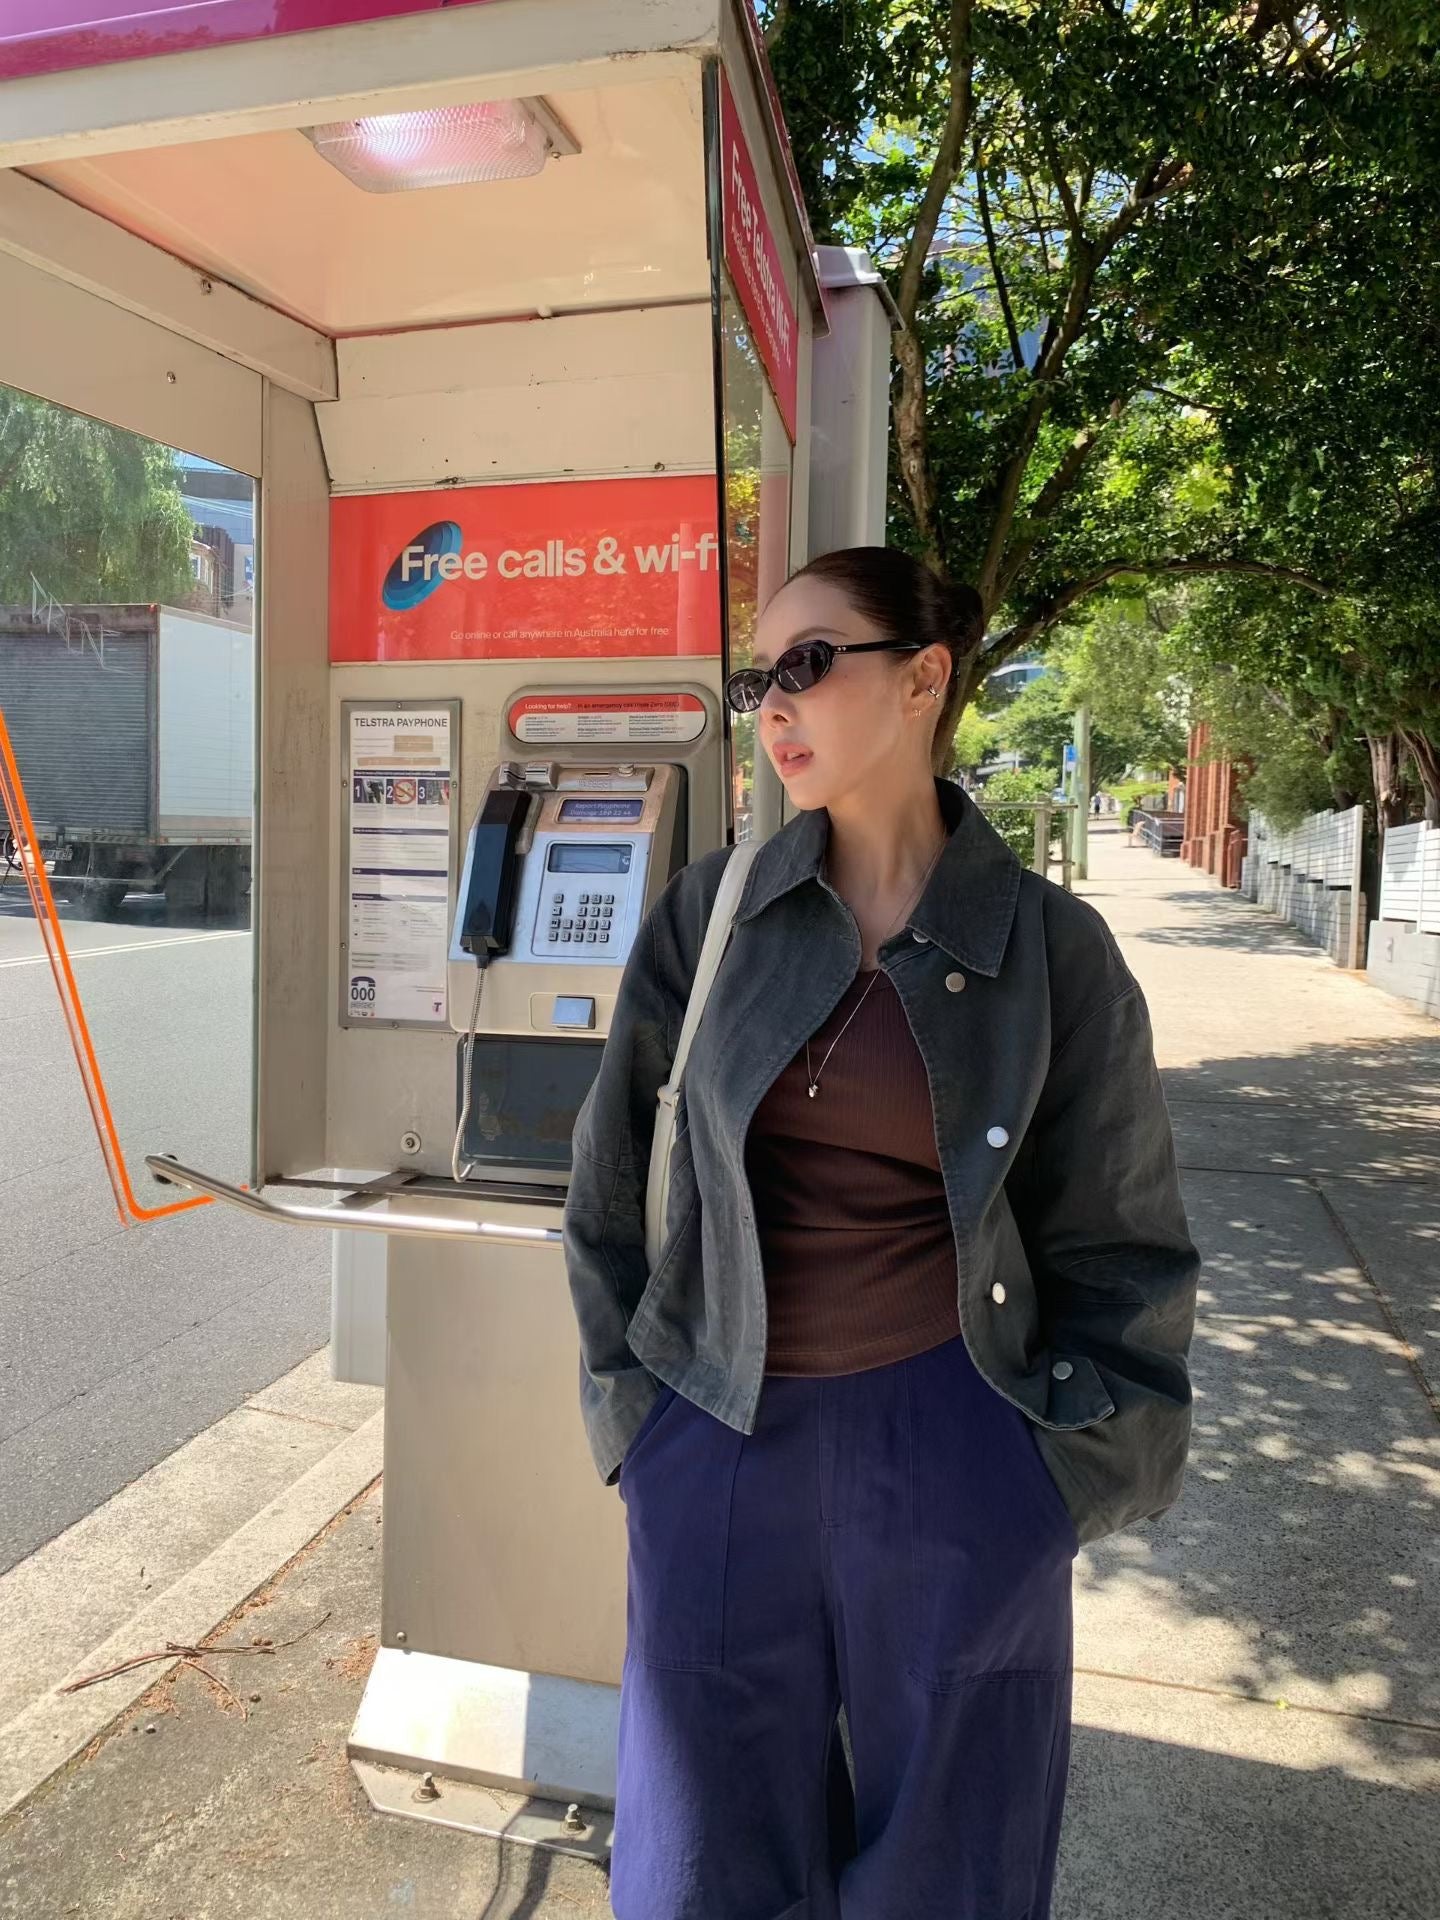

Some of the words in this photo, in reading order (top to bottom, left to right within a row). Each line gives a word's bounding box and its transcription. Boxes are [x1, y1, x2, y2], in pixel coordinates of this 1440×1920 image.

[732, 140, 751, 242] Free
[752, 204, 776, 321] Telstra
[401, 545, 487, 582] Free
[498, 540, 585, 578] calls
[593, 537, 626, 575] &
[633, 532, 719, 573] wi-f
[450, 631, 463, 640] Go
[465, 630, 491, 640] online
[493, 631, 501, 639] or
[503, 630, 517, 639] call
[519, 629, 563, 640] anywhere
[565, 628, 572, 638] in
[573, 627, 612, 638] Australia
[614, 627, 636, 637] here
[636, 626, 648, 636] for
[650, 626, 669, 636] free
[354, 717, 395, 728] TELSTRA
[396, 718, 448, 728] PAYPHONE
[354, 785, 360, 798] 1
[386, 785, 394, 798] 2
[418, 786, 426, 799] 3
[351, 987, 376, 1001] 000
[434, 1002, 442, 1012] T
